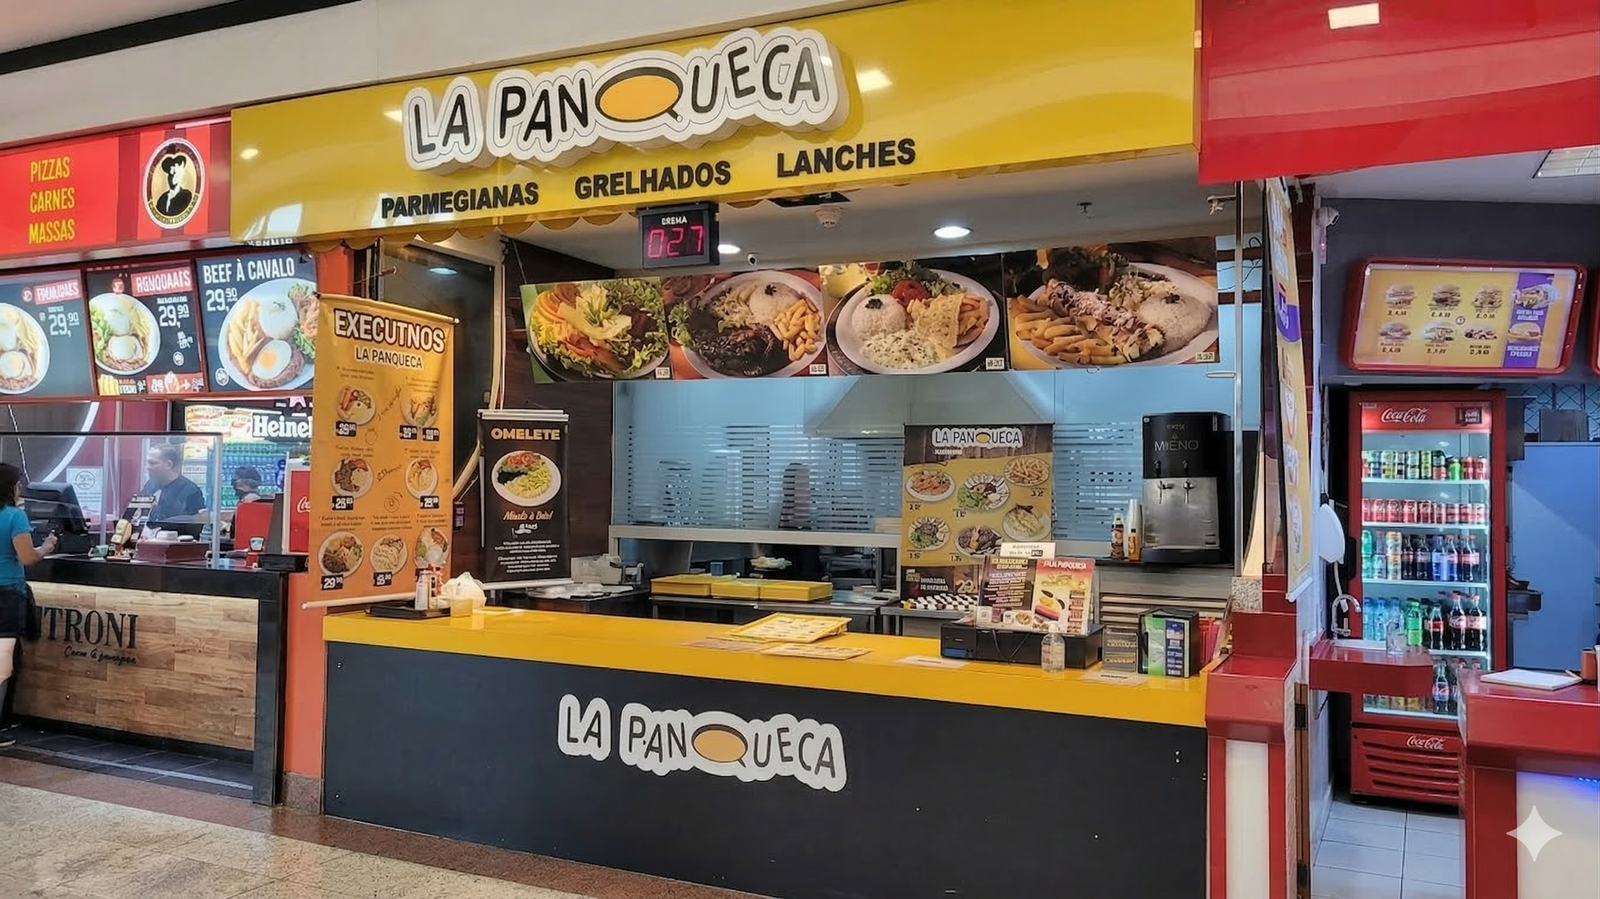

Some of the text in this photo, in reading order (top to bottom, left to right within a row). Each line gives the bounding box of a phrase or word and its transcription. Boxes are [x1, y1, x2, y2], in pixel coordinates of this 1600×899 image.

[412, 43, 824, 155] LA PANQUECA
[30, 156, 71, 183] PIZZAS
[776, 137, 918, 179] LANCHES
[573, 160, 733, 200] GRELHADOS
[29, 187, 76, 215] CARNES
[380, 181, 540, 220] PARMEGIANAS
[28, 219, 76, 245] MASSAS
[647, 225, 705, 258] 027
[202, 256, 296, 284] BEEF À CAVALO
[354, 346, 424, 370] LA PANQUECA
[252, 414, 313, 439] Heine
[490, 427, 561, 441] OMELETE
[935, 431, 1021, 444] LA PANQUECA
[43, 606, 139, 649] TRONI
[566, 705, 836, 780] LA PANQUECA
